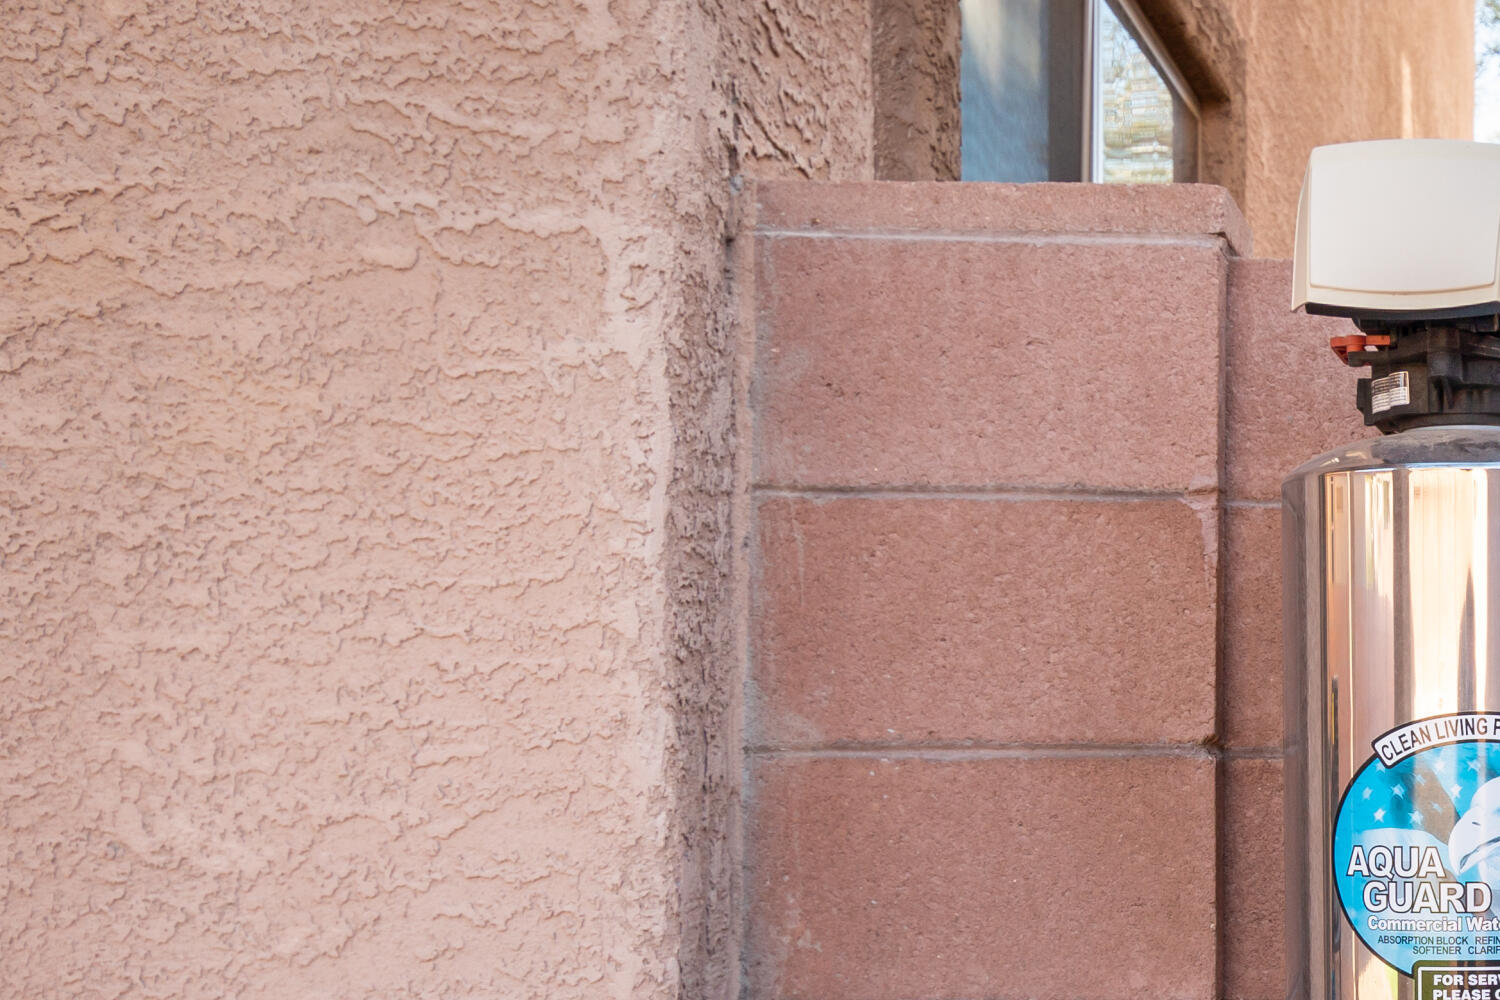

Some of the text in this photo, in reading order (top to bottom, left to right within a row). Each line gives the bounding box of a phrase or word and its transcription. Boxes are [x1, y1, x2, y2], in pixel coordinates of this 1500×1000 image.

[1381, 725, 1431, 761] CLEAN
[1436, 717, 1488, 740] LIVING
[1347, 845, 1446, 880] AQUA
[1363, 880, 1492, 913] GUARD
[1367, 915, 1462, 932] Commercial
[1378, 935, 1434, 945] ABSORPTION
[1436, 936, 1468, 945] BLOCK
[1412, 946, 1462, 955] SOFTENER
[1433, 974, 1464, 986] FOR
[1432, 989, 1491, 1000] PLEASE
